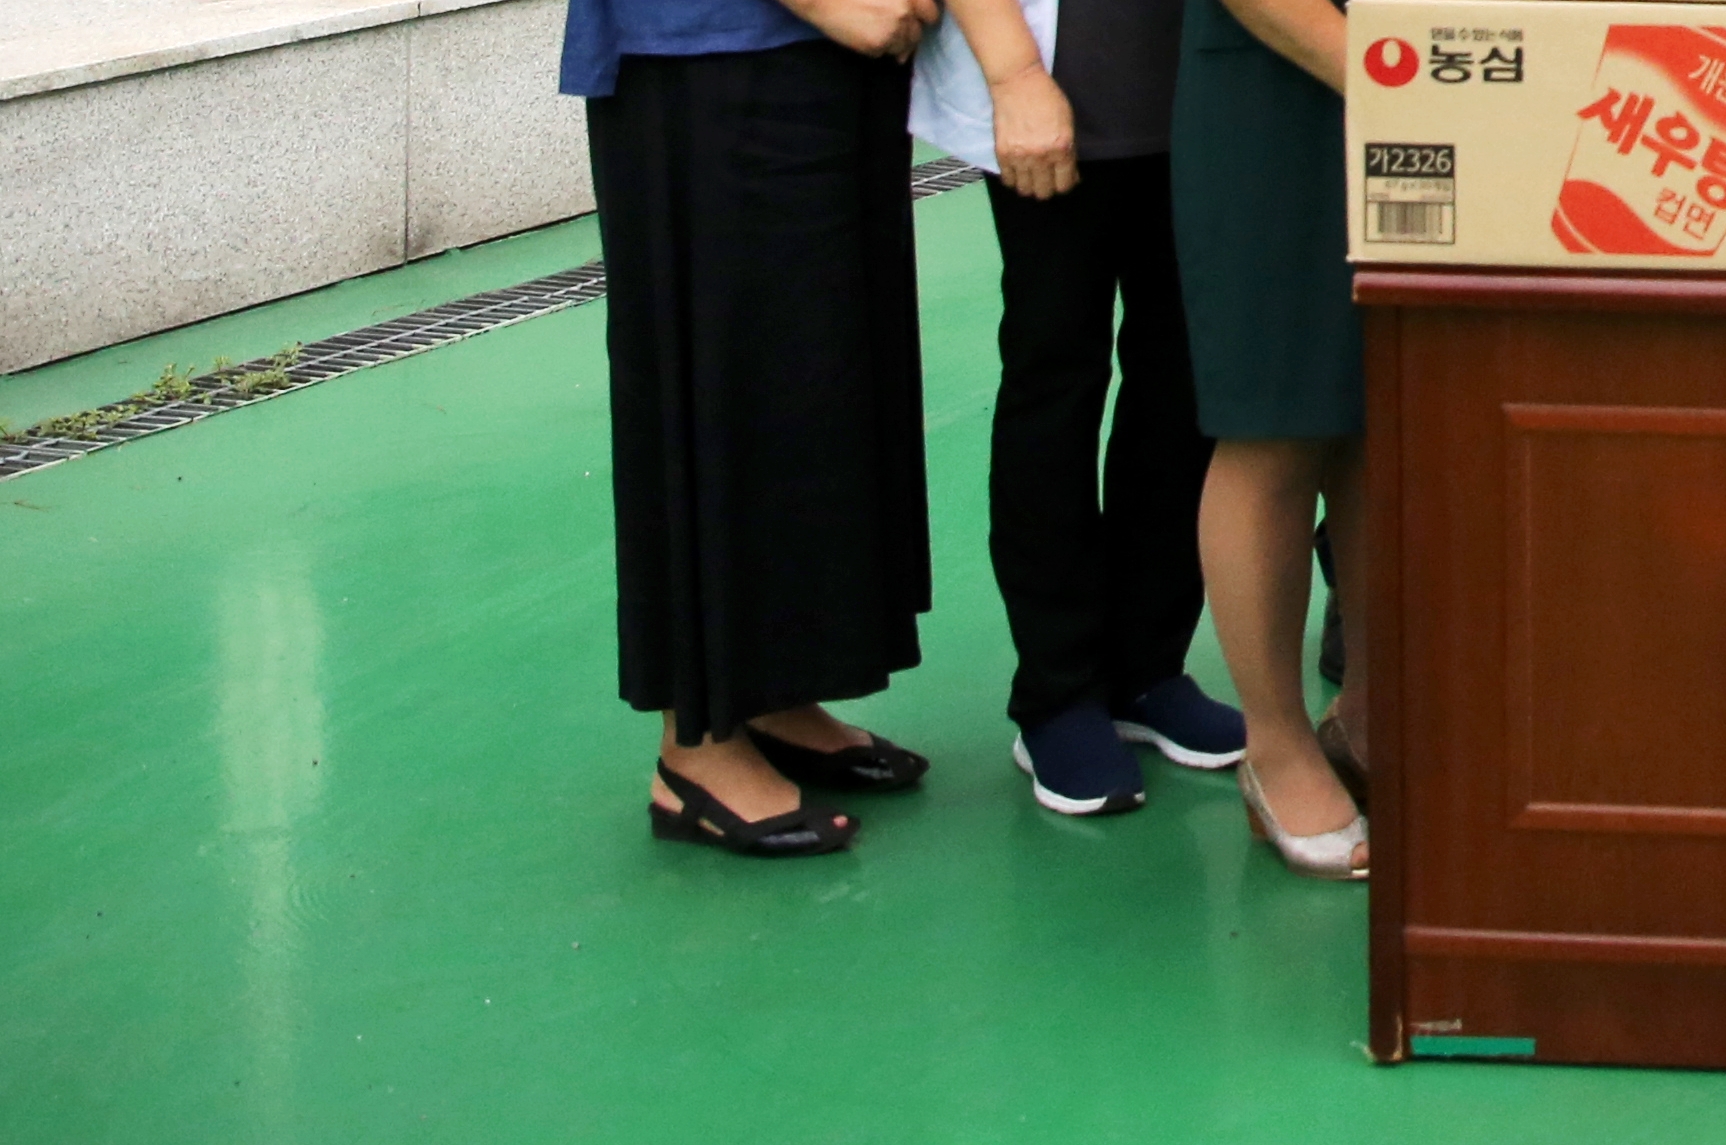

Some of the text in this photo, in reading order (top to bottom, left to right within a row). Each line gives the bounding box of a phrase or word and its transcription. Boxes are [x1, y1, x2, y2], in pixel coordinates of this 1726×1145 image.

[1428, 44, 1523, 83] 농심
[1369, 147, 1452, 174] 가2326
[1654, 187, 1716, 241] 컵면
